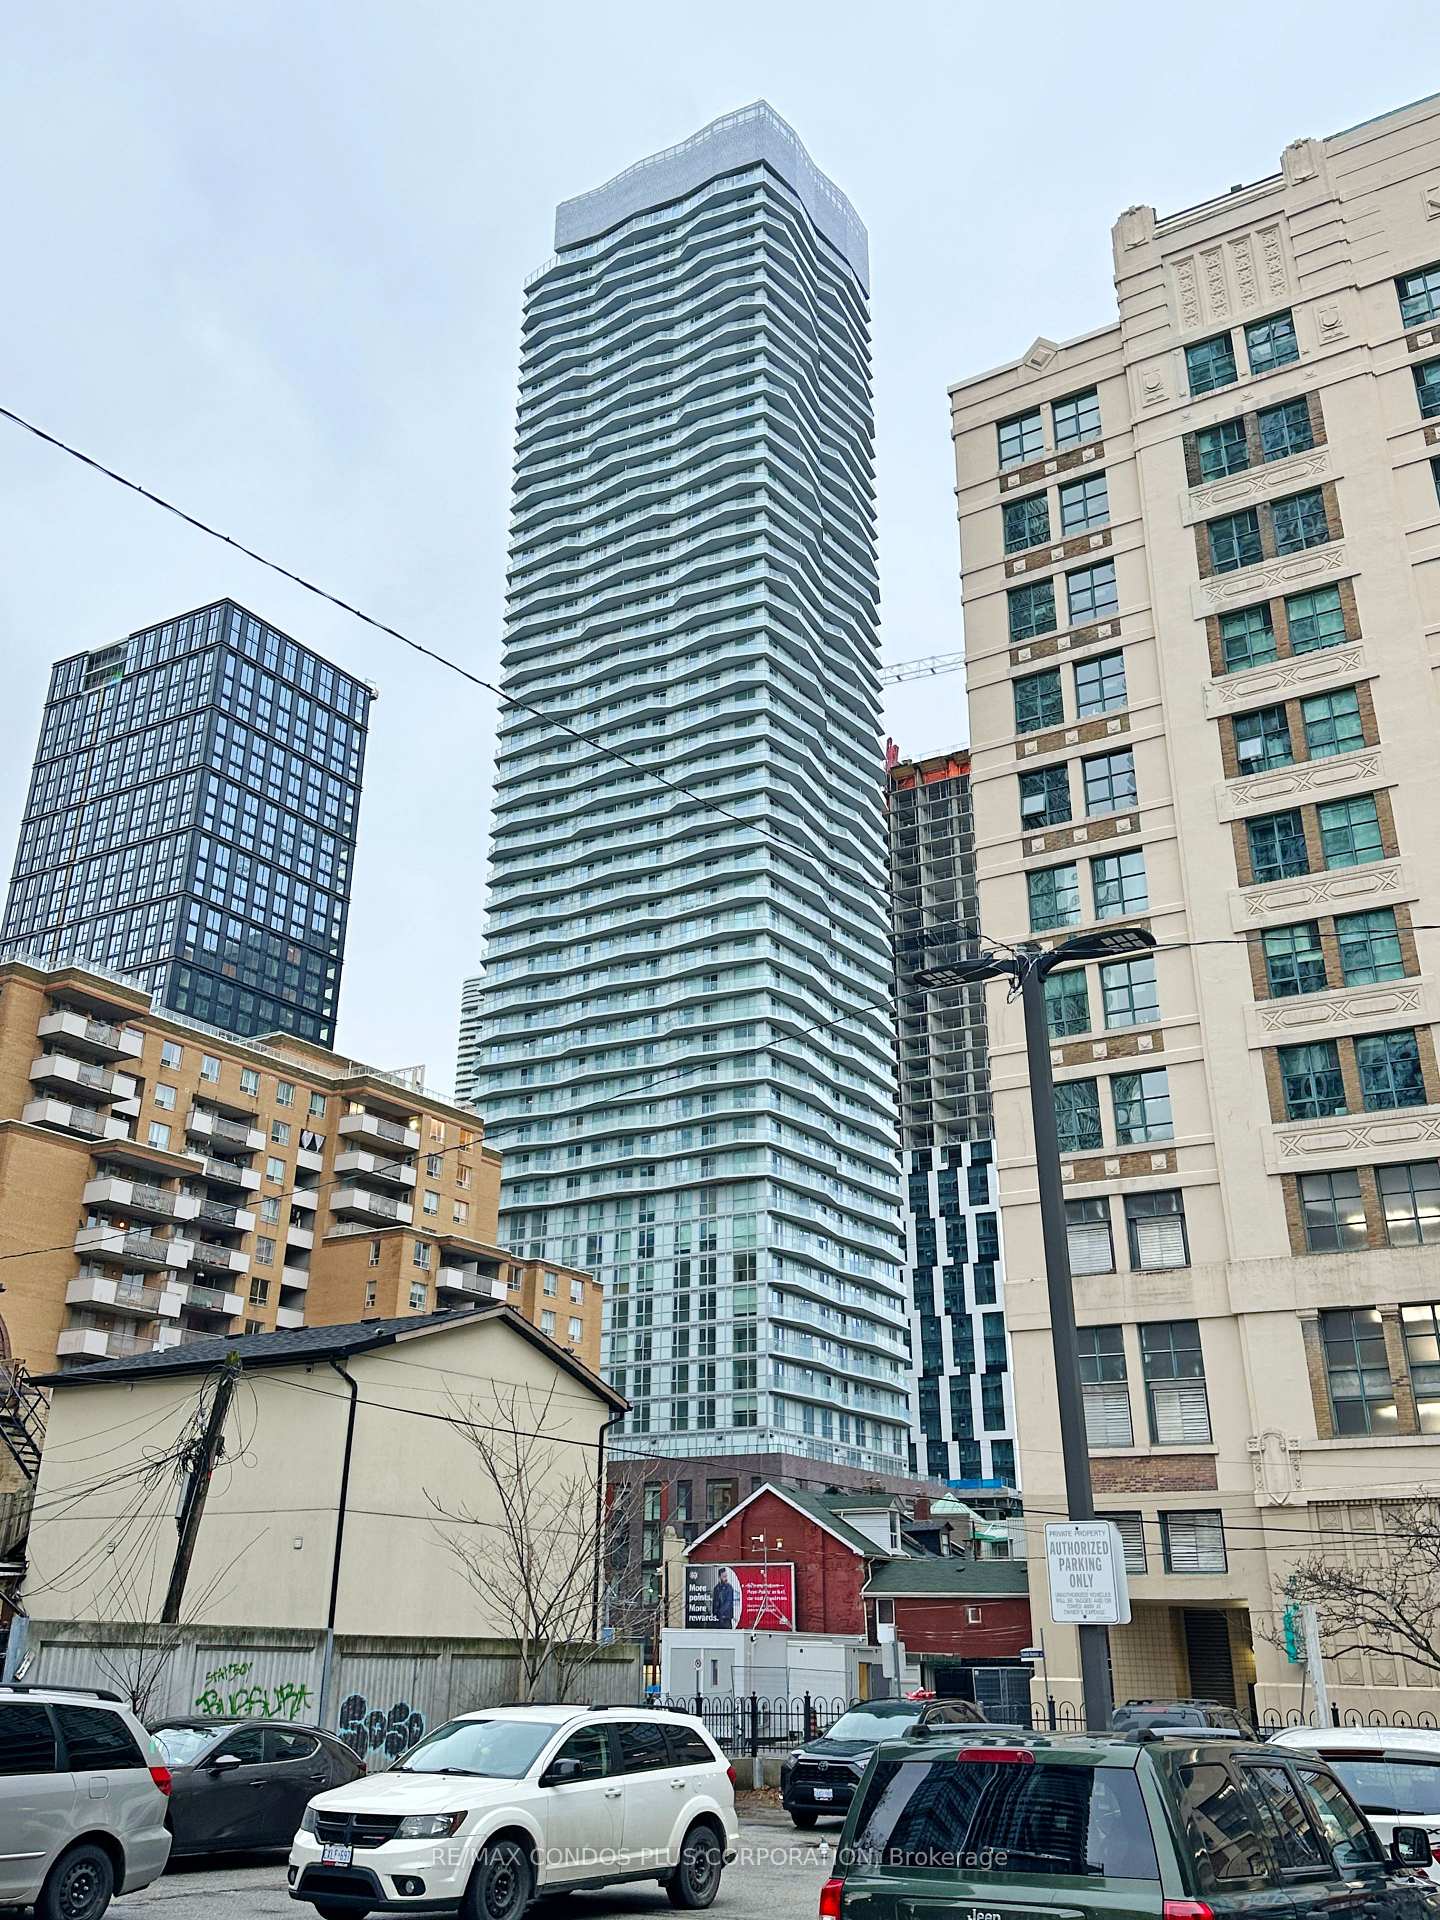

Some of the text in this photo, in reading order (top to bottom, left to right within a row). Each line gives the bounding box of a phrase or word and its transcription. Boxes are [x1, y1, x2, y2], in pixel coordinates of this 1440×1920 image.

[1049, 1541, 1109, 1555] AUTHORIZED
[1059, 1557, 1102, 1571] PARKING
[1069, 1573, 1093, 1588] ONLY
[689, 1584, 707, 1592] More
[689, 1593, 713, 1602] points.
[689, 1604, 707, 1612] More
[688, 1613, 719, 1622] rewards.
